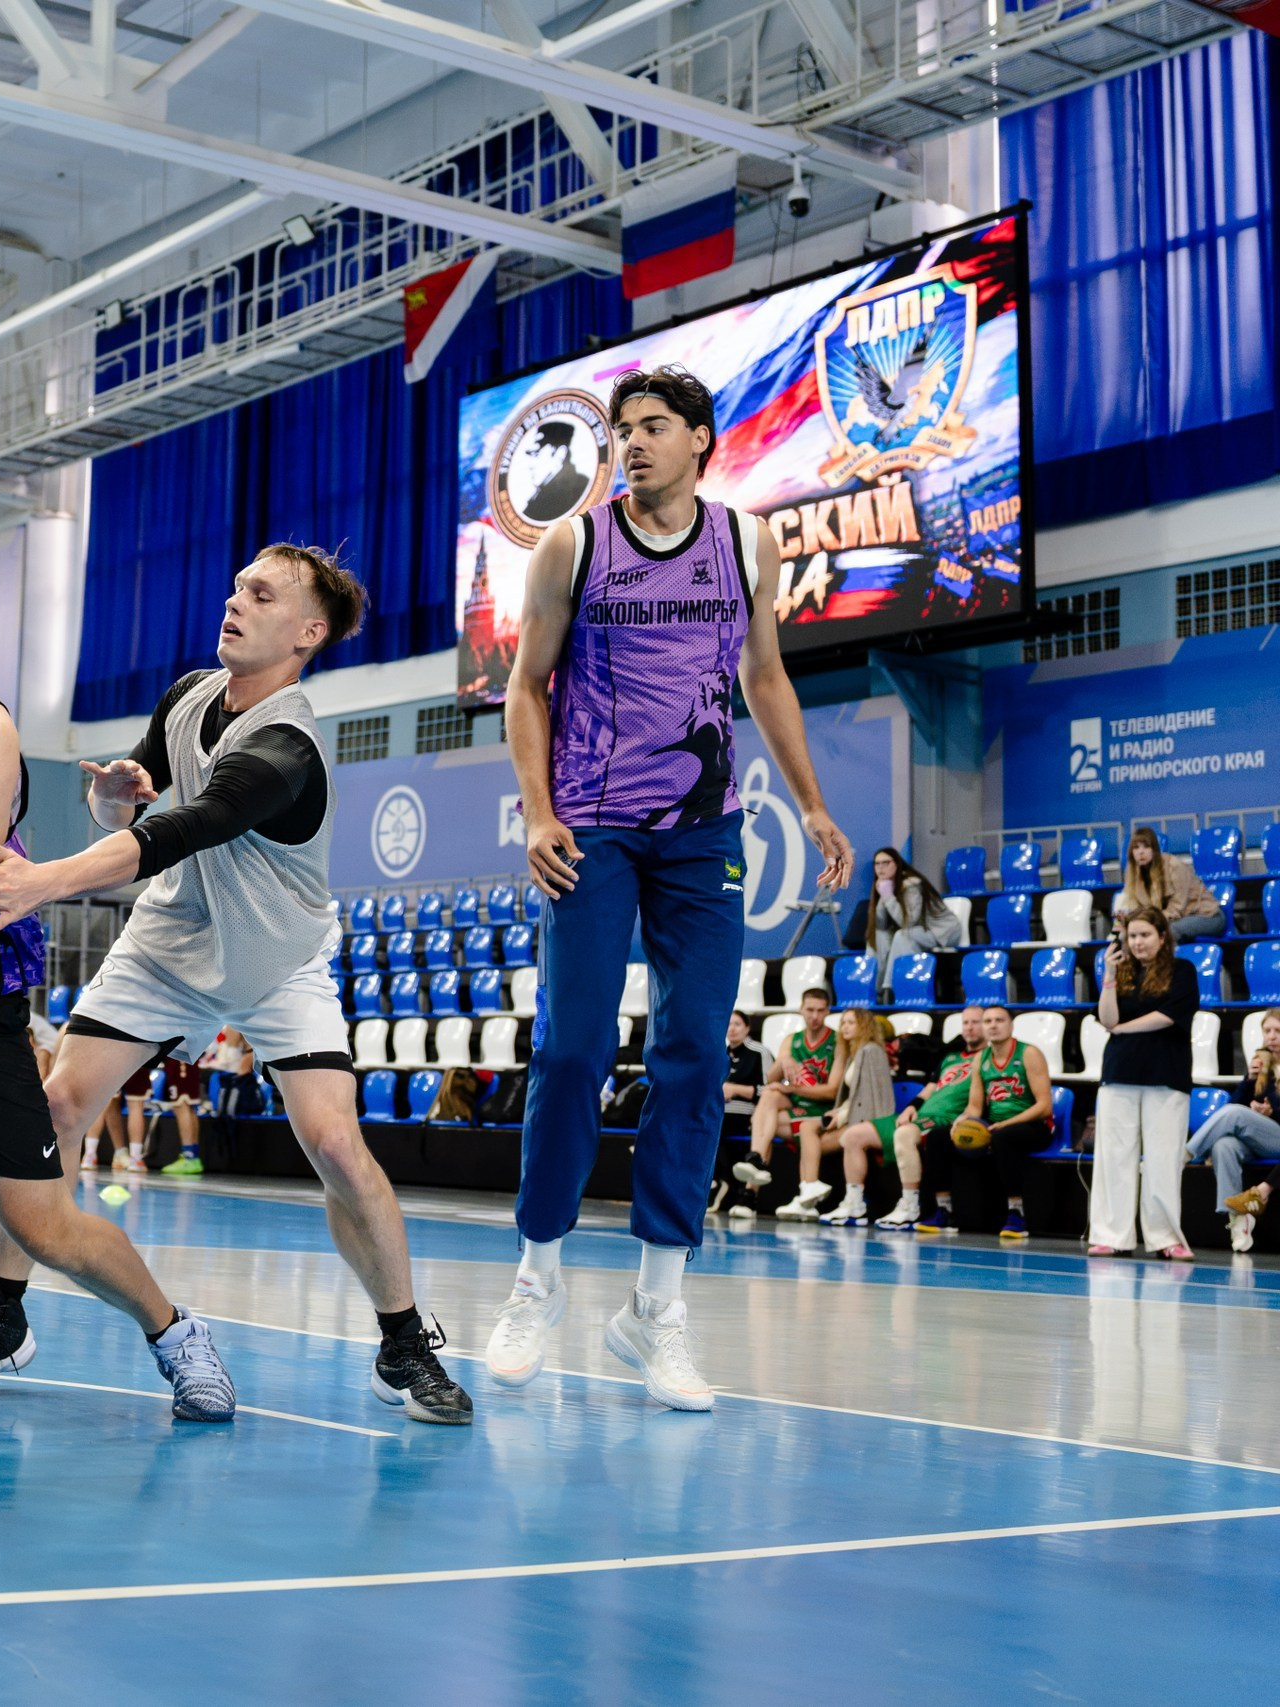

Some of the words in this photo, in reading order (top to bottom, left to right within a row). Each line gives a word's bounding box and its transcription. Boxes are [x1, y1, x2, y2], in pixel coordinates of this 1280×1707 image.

[845, 282, 946, 347] ЛДПР
[767, 472, 921, 560] СКИЙ
[969, 495, 1022, 536] ЛДПР
[604, 570, 649, 587] ЛДПР
[586, 602, 654, 625] СОКОЛЫ
[656, 599, 739, 624] ПРИМОРЬЯ
[1109, 707, 1216, 738] ТЕЛЕВИДЕНИЕ
[1109, 743, 1121, 762] И
[1123, 737, 1175, 760] РАДИО
[1109, 754, 1221, 784] ПРИМОРСКОГО
[1224, 749, 1266, 771] КРАЯ
[1070, 780, 1103, 794] РЕГИОН
